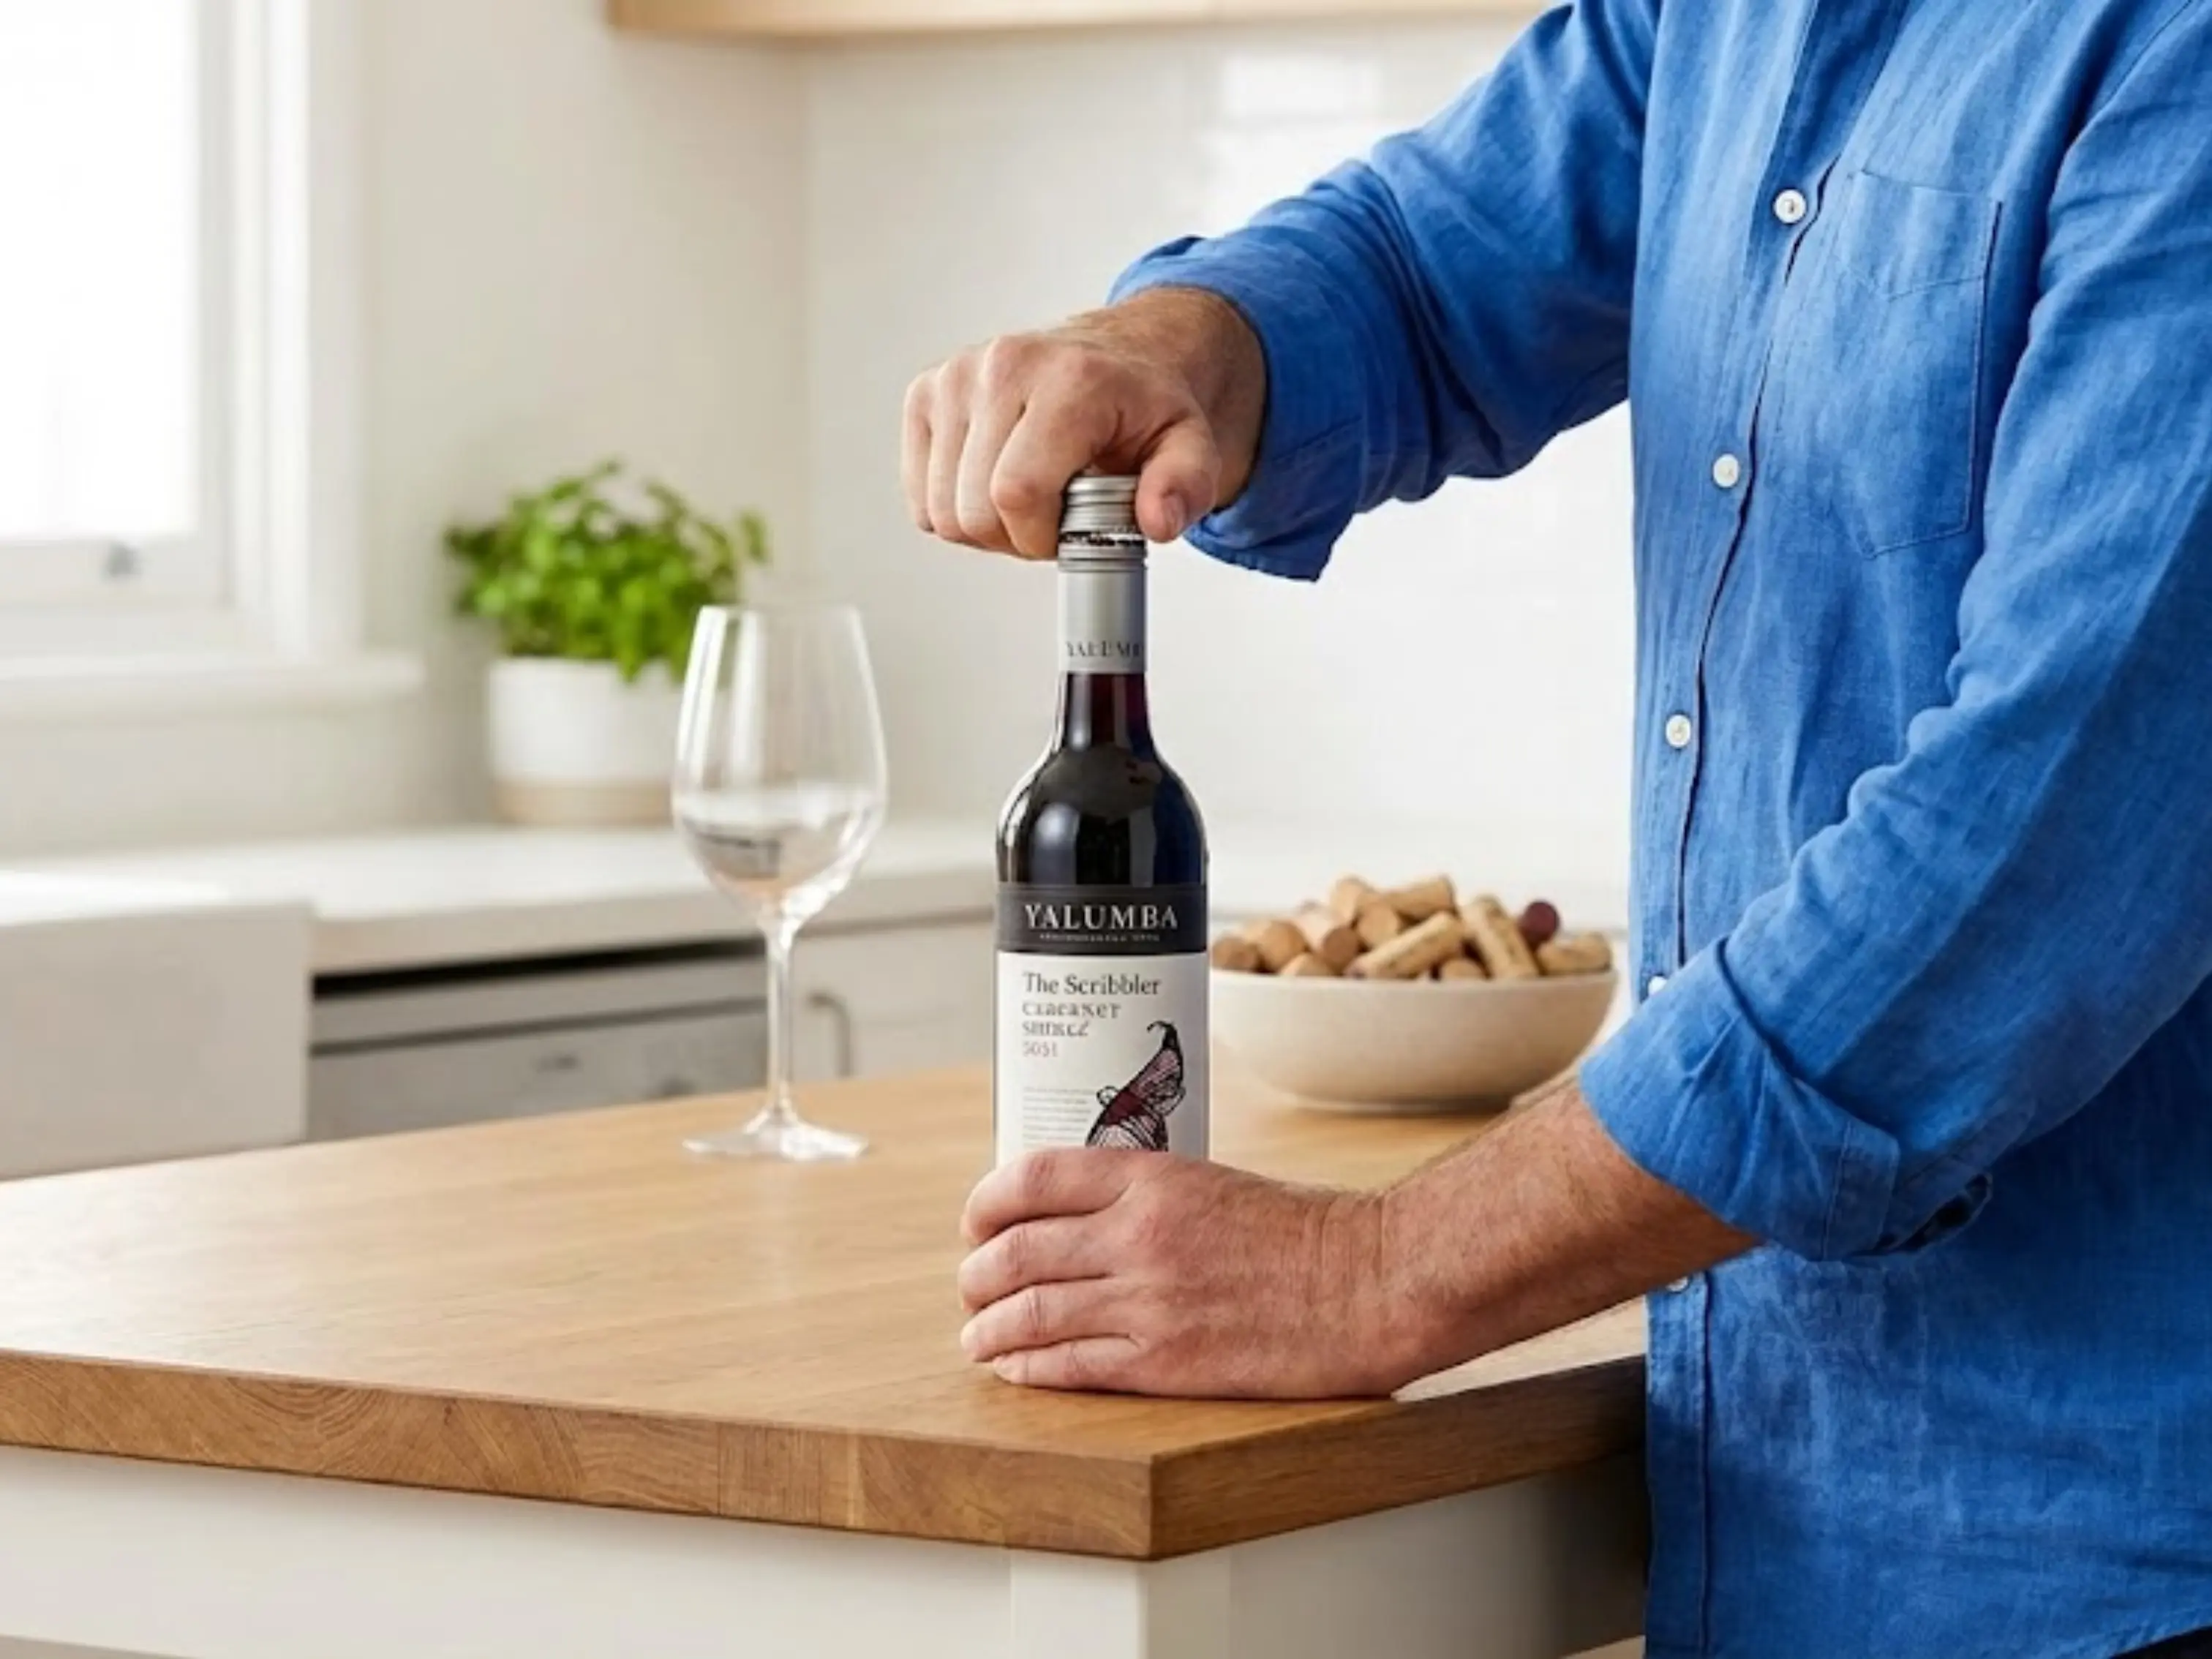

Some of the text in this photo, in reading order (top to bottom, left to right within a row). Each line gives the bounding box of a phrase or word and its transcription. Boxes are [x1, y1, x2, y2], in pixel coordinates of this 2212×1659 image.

[1024, 903, 1178, 930] YALUMBA
[1023, 972, 1161, 996] The Scribbler
